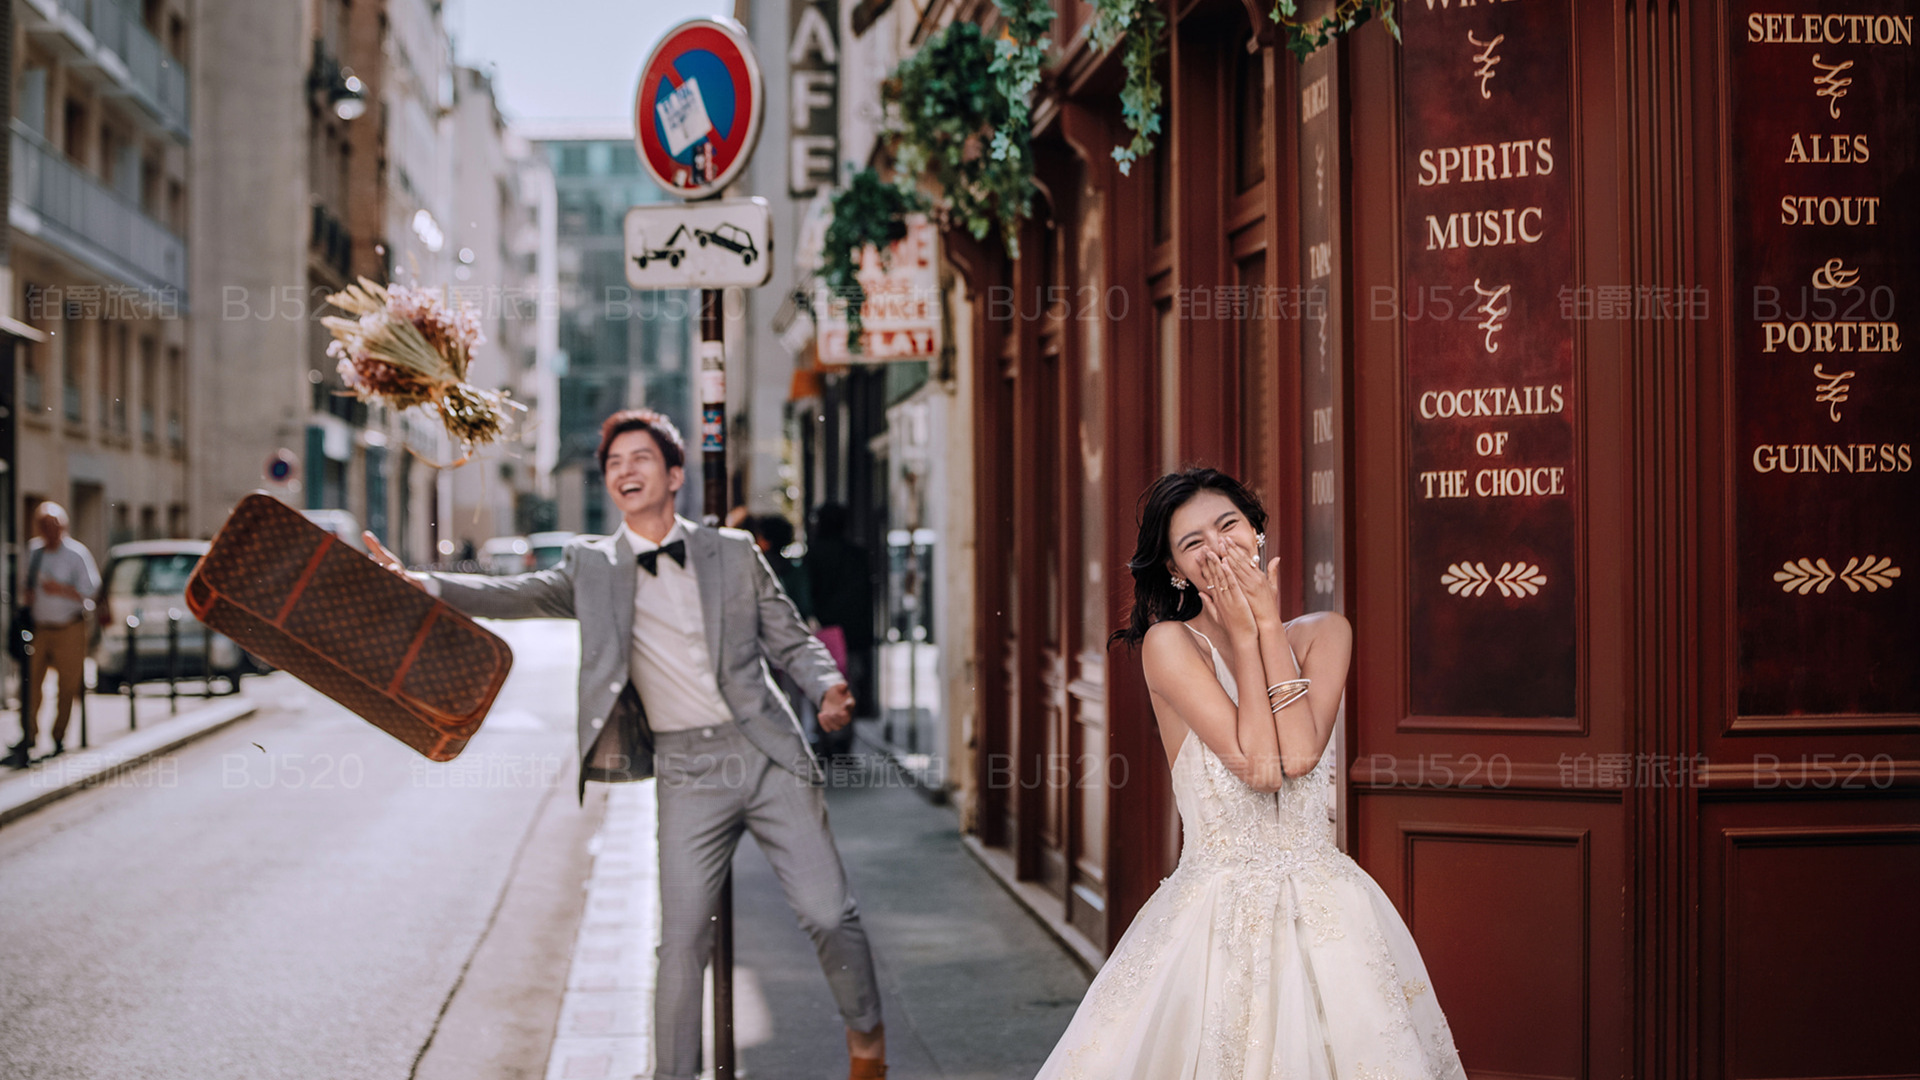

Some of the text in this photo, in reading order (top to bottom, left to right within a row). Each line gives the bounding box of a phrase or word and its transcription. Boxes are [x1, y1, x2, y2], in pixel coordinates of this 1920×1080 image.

[1747, 13, 1913, 45] SELECTION
[1418, 138, 1554, 187] SPIRITS
[1785, 133, 1870, 164] ALES
[1781, 196, 1880, 226] STOUT
[1426, 207, 1543, 251] MUSIC
[1811, 258, 1860, 290] &
[1762, 321, 1902, 354] PORTER
[1420, 385, 1564, 419] COCKTAILS
[1476, 432, 1508, 456] OF
[1753, 444, 1912, 474] GUINNESS
[1421, 467, 1565, 499] THE CHOICE
